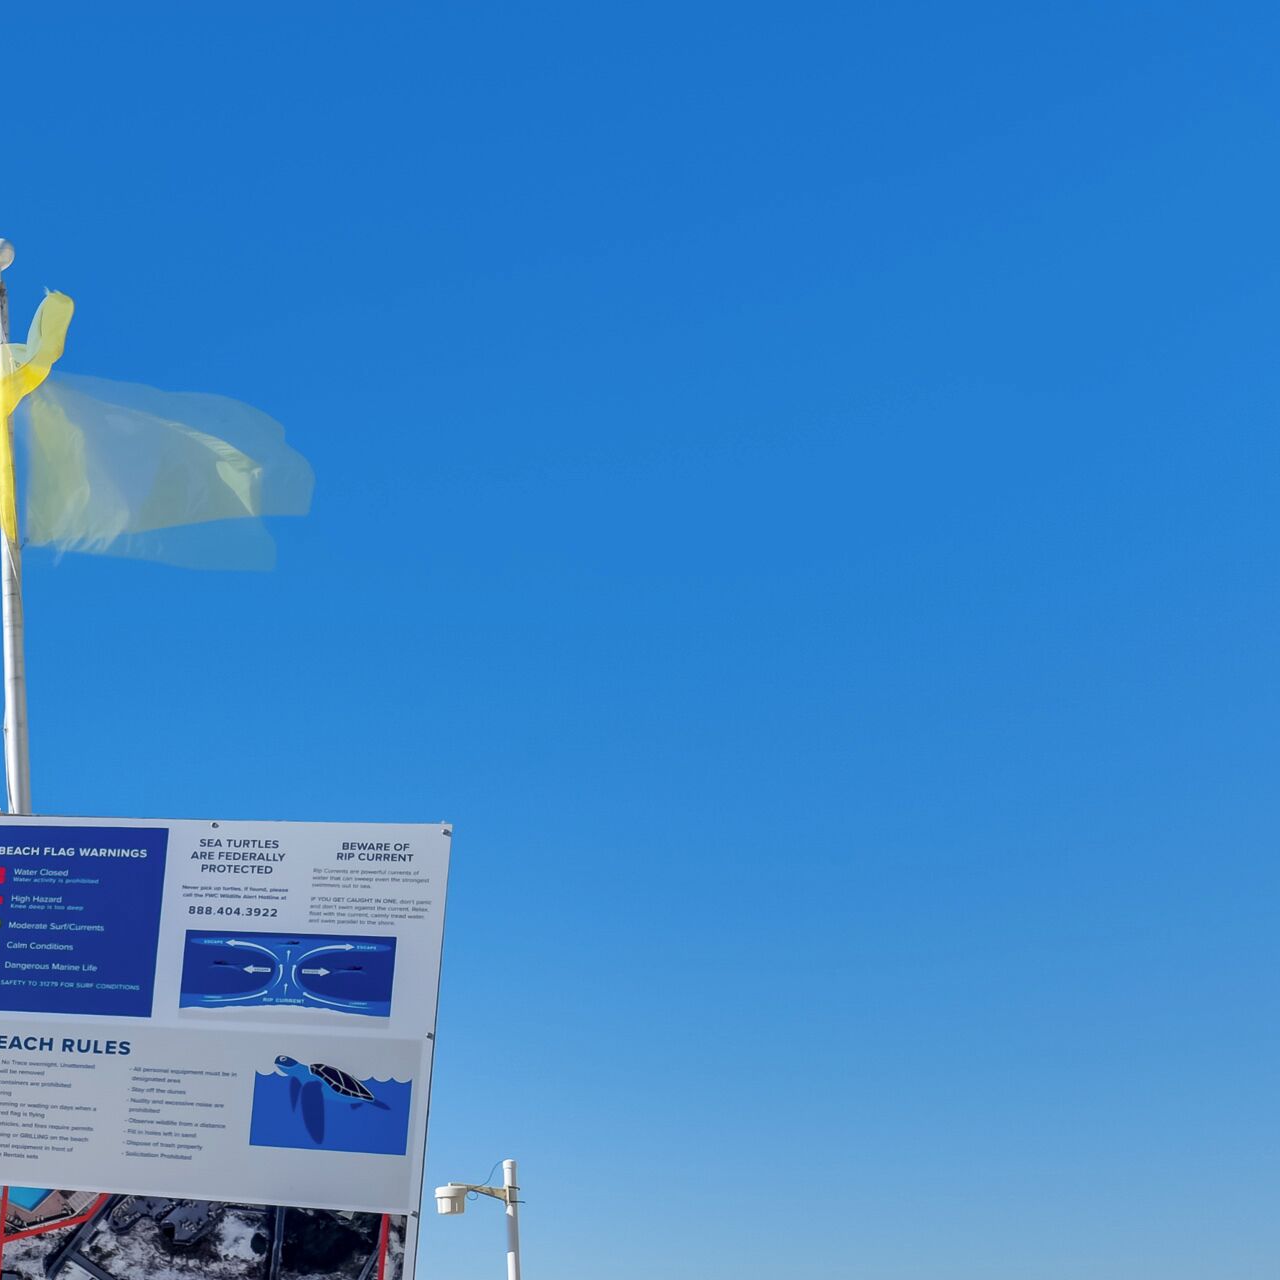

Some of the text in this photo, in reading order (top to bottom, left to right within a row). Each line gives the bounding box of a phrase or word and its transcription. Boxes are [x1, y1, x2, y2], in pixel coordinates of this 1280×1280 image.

[199, 839, 279, 848] SEA TURTLES
[342, 842, 410, 851] BEWARE OF
[43, 848, 75, 856] FLAG
[79, 848, 147, 858] WARNINGS
[191, 851, 286, 861] ARE FEDERALLY
[336, 853, 414, 862] RIP CURRENT
[14, 868, 37, 876] Water
[201, 864, 273, 874] PROTECTED
[11, 896, 30, 904] High
[188, 906, 278, 917] 888.404.3922
[8, 922, 105, 931] Moderate Surf/Currents
[6, 941, 74, 950] Calm Conditions
[4, 961, 49, 971] Dangerous
[52, 963, 80, 971] Marine
[62, 1039, 131, 1055] RULES
